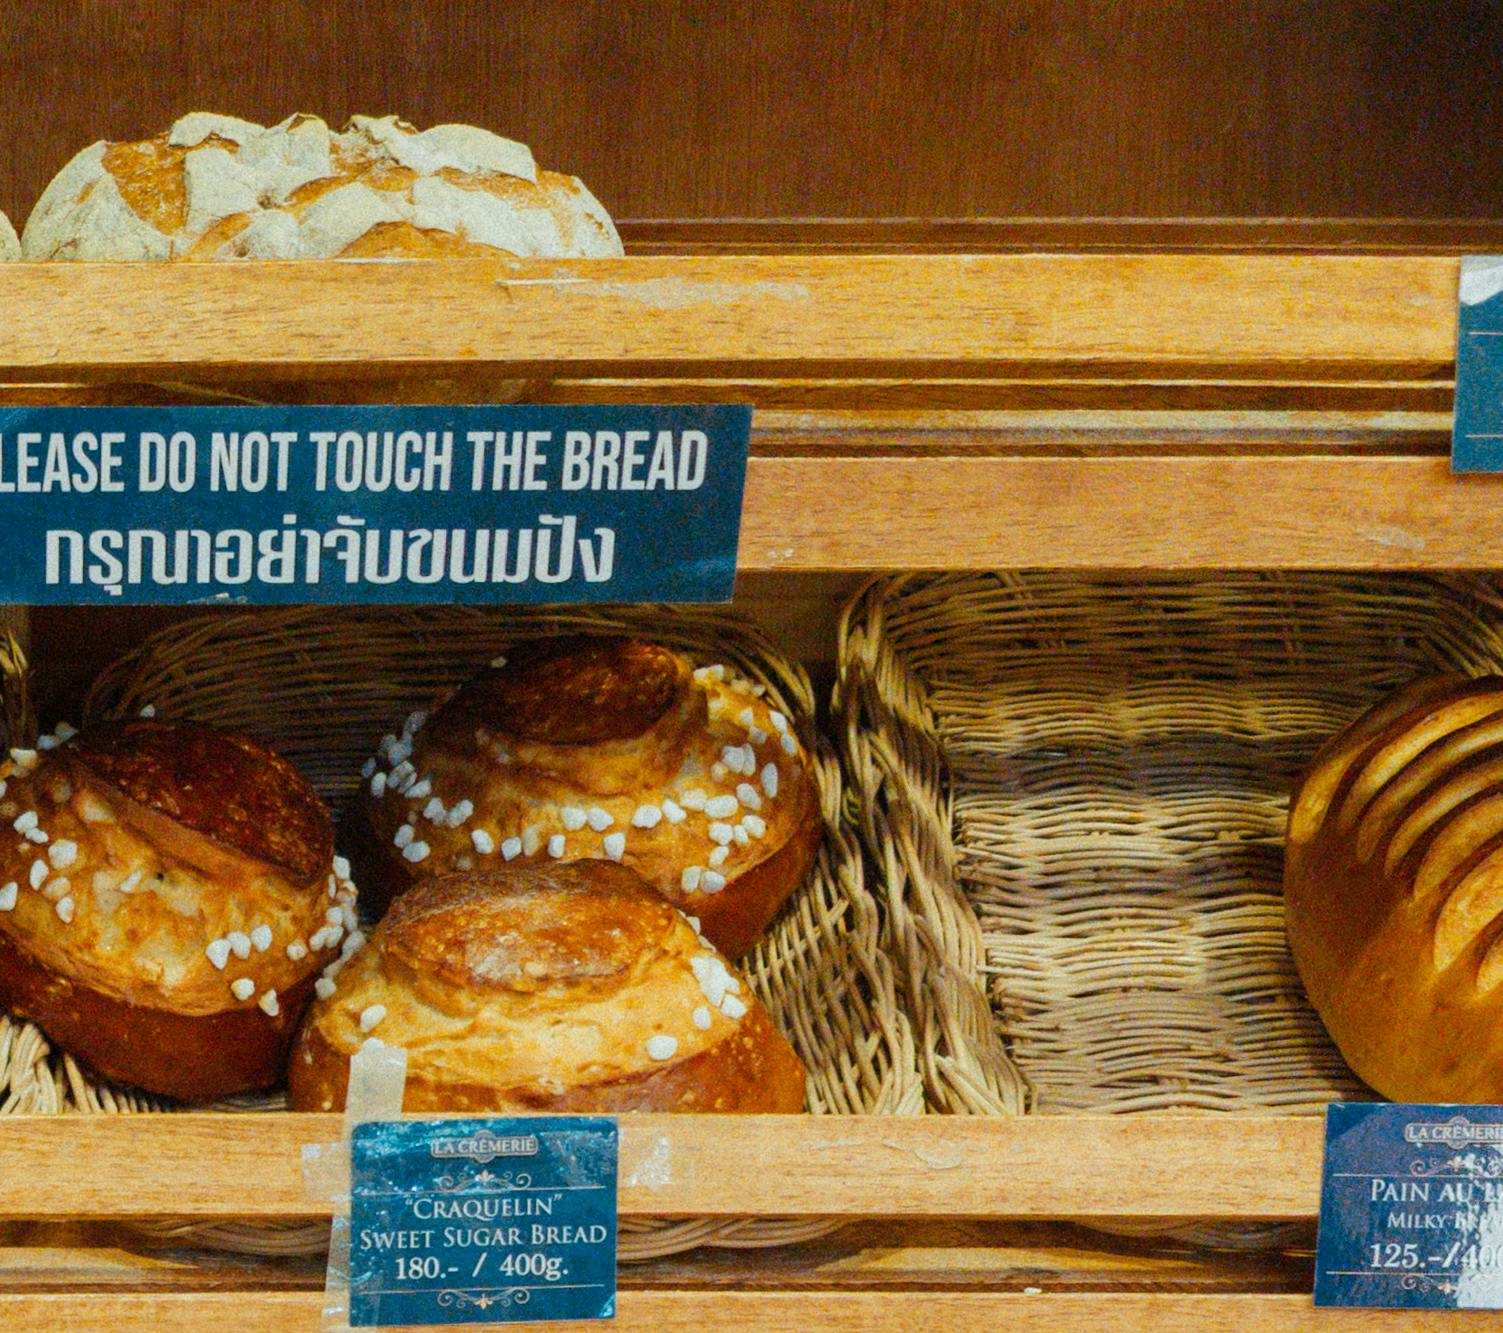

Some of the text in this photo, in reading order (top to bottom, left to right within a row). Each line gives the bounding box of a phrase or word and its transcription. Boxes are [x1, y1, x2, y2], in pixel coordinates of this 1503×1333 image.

[139, 431, 196, 493] DO
[209, 431, 297, 493] NOT
[309, 430, 453, 493] TOUCH
[466, 430, 557, 492] THE
[561, 430, 708, 491] BREAD
[45, 513, 616, 597] กรุณาอย่าจับขนมปัง
[1408, 1125, 1428, 1140] LA
[434, 1141, 454, 1154] LA
[1371, 1179, 1429, 1202] PAIN
[1438, 1182, 1473, 1202] AU
[1387, 1211, 1447, 1229] MILKY
[360, 1225, 608, 1249] SWEET SUGAR BREAD
[396, 1253, 569, 1281] 180.- / 400g.
